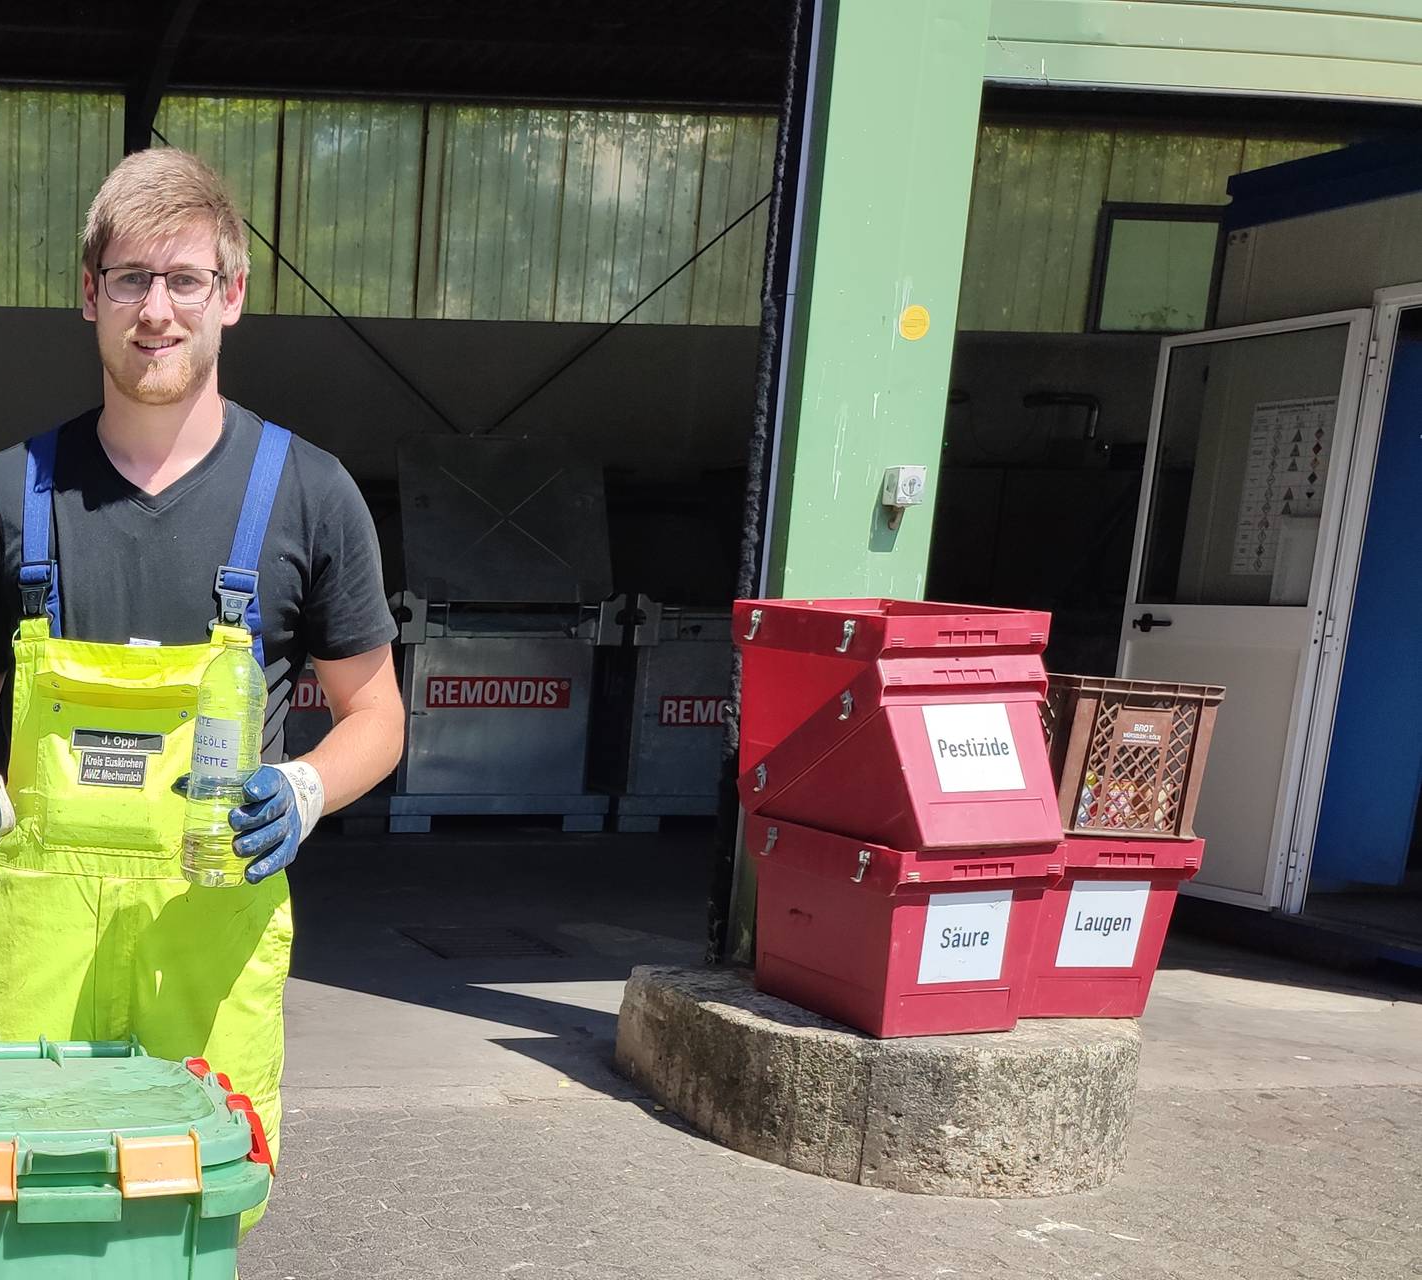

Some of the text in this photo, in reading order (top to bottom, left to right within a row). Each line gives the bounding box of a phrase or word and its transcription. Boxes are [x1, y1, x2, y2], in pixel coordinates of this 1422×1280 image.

[101, 735, 111, 746] J.
[937, 737, 1010, 758] Pestizide
[85, 754, 144, 769] Kreis Euskirchen
[83, 768, 142, 782] AWZ Mechernich
[1074, 911, 1132, 937] Laugen
[940, 926, 990, 949] Säure
